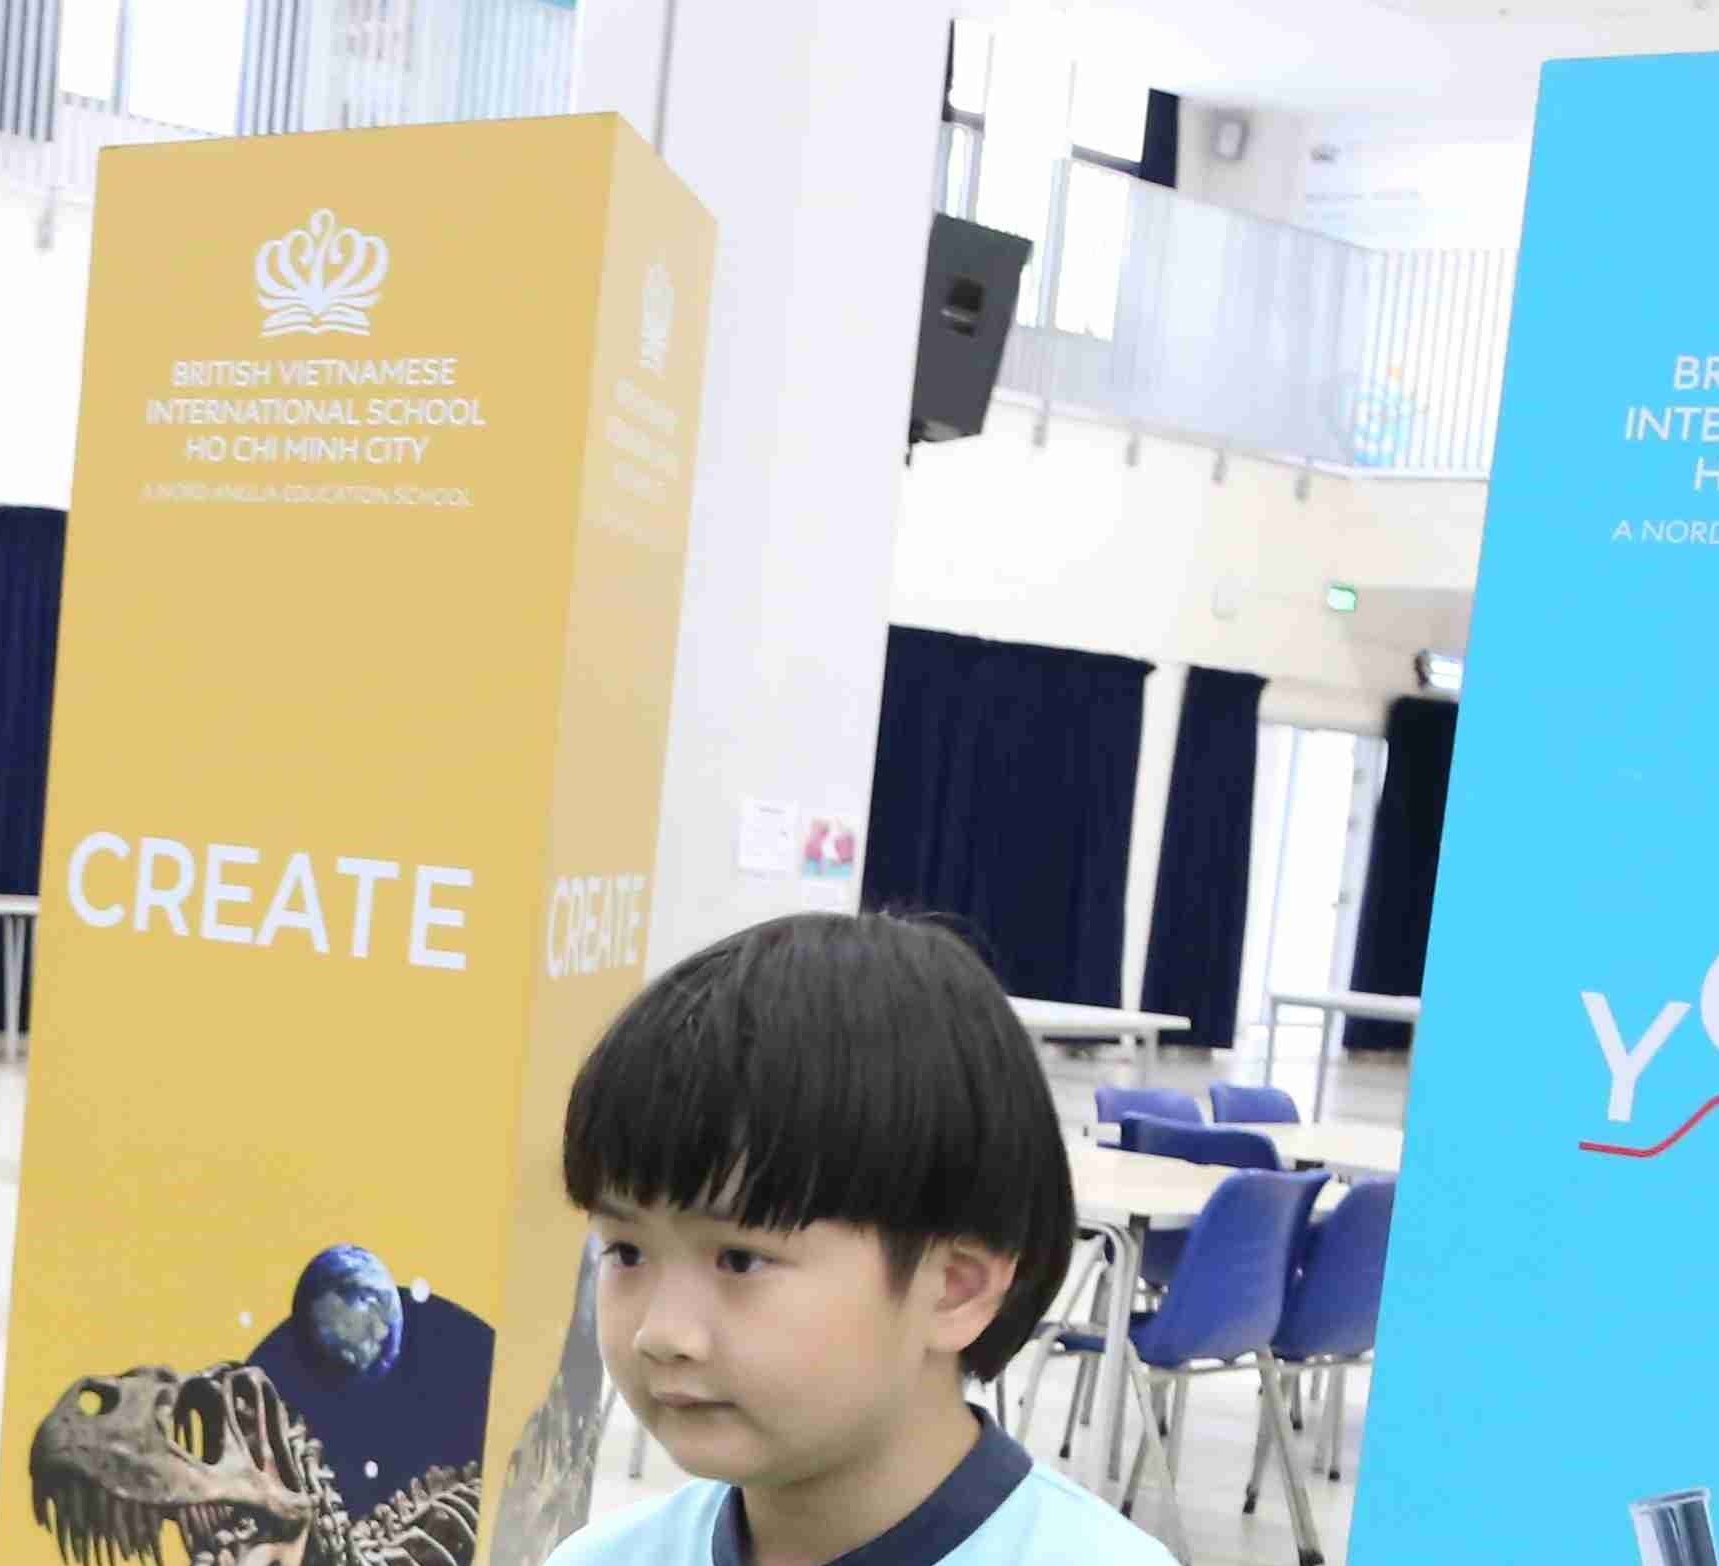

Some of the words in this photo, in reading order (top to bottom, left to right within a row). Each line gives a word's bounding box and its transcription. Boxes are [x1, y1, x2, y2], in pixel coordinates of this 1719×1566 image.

[171, 358, 272, 387] BRITISH
[278, 356, 459, 387] VIETNAMESE
[144, 398, 362, 426] INTERNATIONAL
[365, 397, 488, 426] SCHOOL
[185, 436, 227, 463] HO
[232, 436, 278, 463] CHI
[284, 436, 359, 464] MINH
[364, 436, 430, 465] CITY
[1612, 519, 1634, 541] A
[68, 831, 474, 971] CREATE
[544, 873, 647, 979] CREATE
